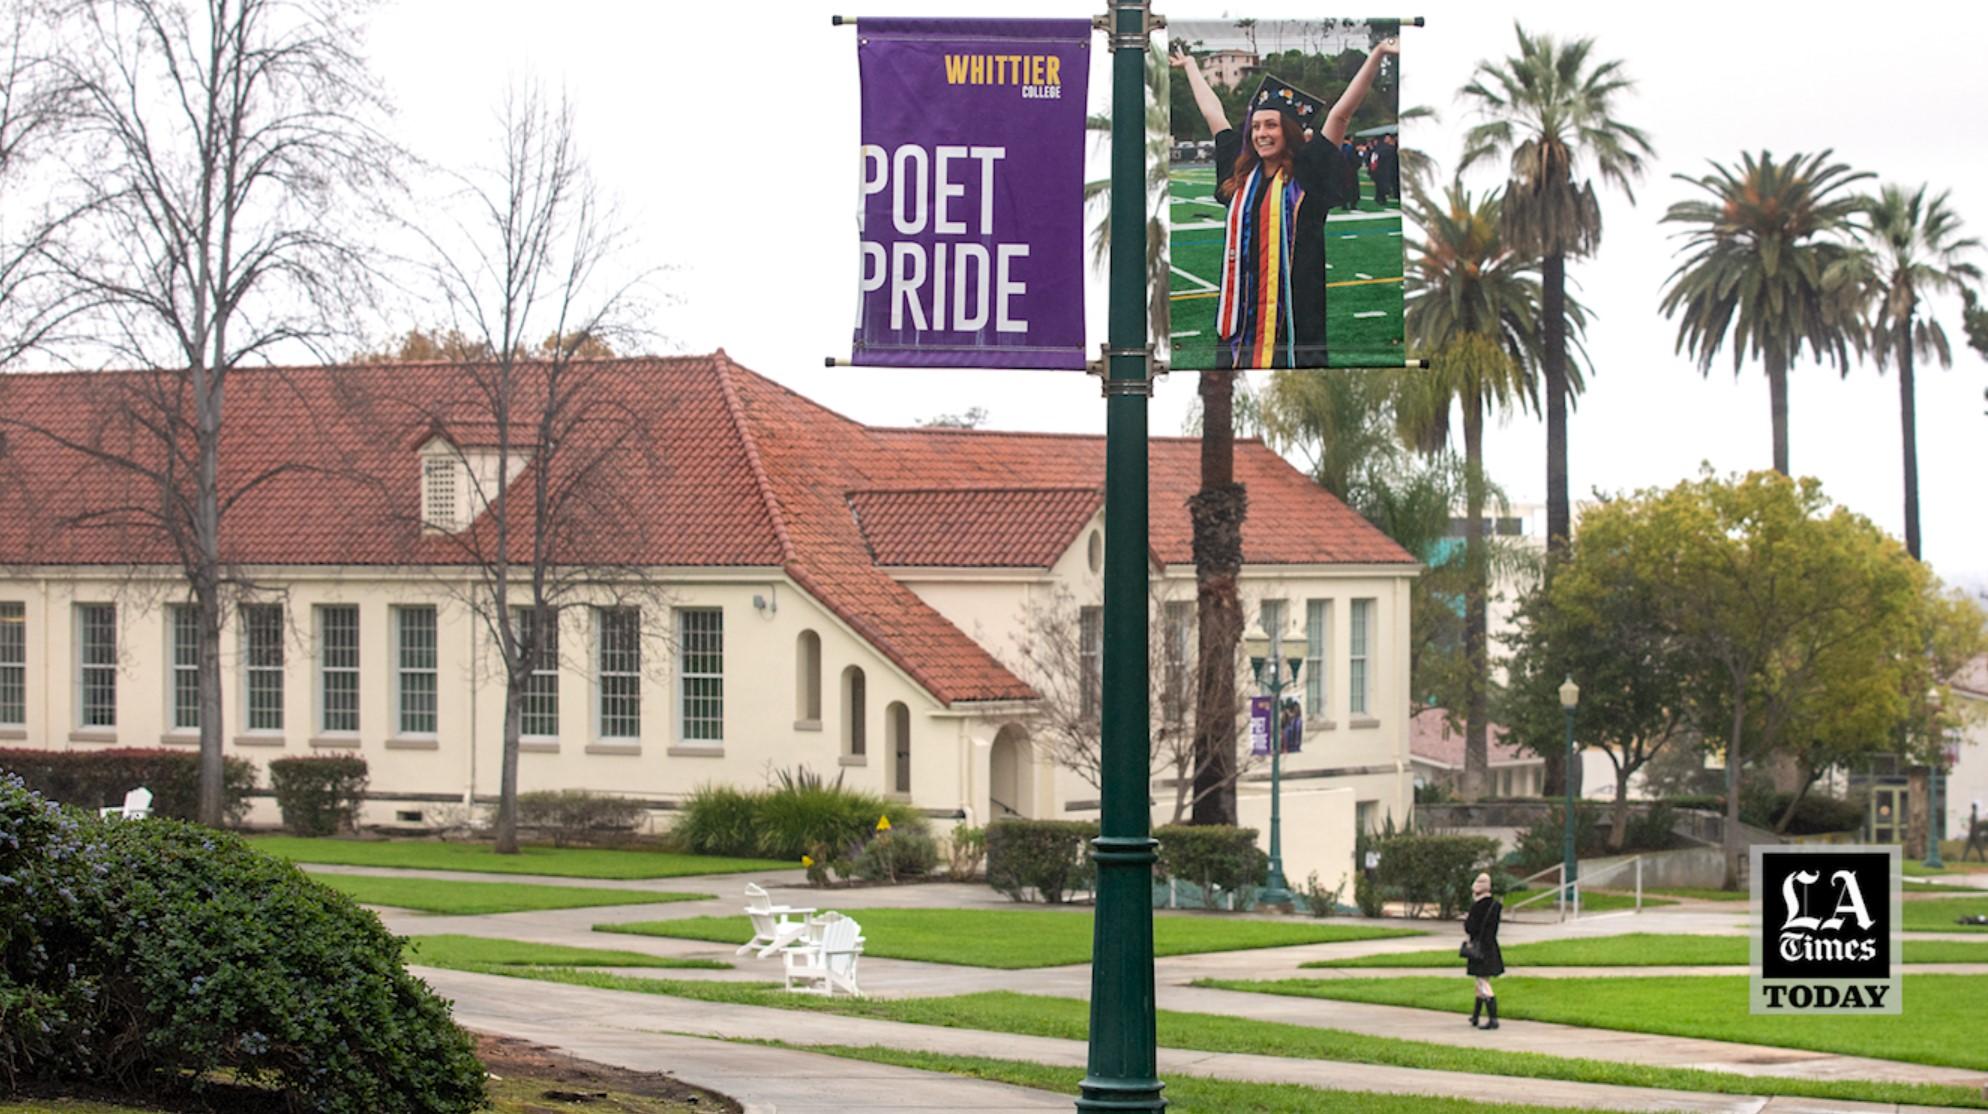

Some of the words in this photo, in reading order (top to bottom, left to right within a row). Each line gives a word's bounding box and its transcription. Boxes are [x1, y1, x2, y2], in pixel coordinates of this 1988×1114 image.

[945, 55, 1061, 85] WHITTIER
[1022, 86, 1061, 98] COLLEGE
[857, 144, 1006, 235] POET
[854, 241, 1030, 332] PRIDE
